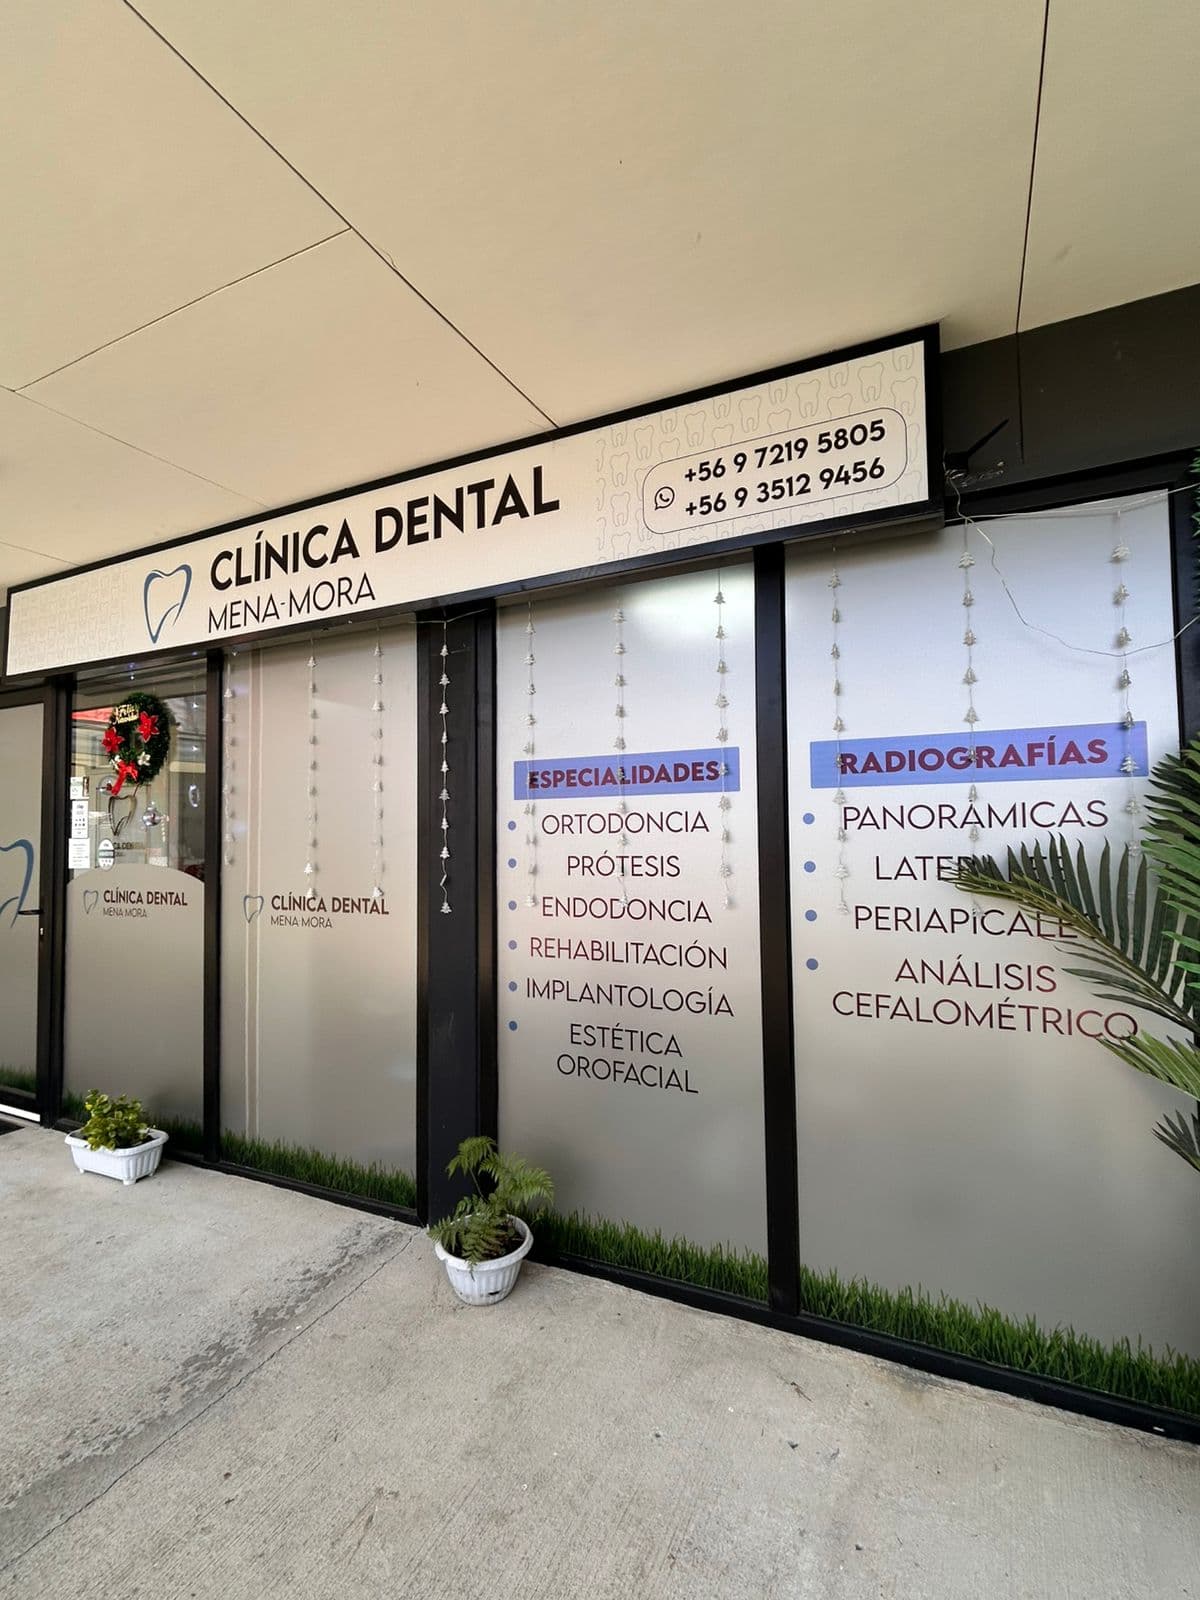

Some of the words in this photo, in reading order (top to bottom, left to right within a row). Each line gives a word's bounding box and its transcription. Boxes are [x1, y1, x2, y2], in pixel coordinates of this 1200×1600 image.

[684, 458, 726, 482] +56
[733, 453, 747, 473] 9
[754, 437, 809, 469] 7219
[817, 419, 886, 454] 5805
[685, 492, 727, 516] +56
[734, 487, 748, 508] 9
[756, 473, 811, 503] 3512
[819, 457, 885, 490] 9456
[210, 517, 360, 591] CLÍNICA
[375, 465, 560, 554] DENTAL
[207, 572, 376, 634] MENA-MORA
[840, 735, 1109, 775] RADIOGRAFÍAS
[528, 760, 720, 790] ESPECIALIDADES
[541, 811, 710, 835] ORTODONCIA
[842, 799, 1109, 831] PANORÁMICAS
[567, 849, 681, 878] PRÓTESIS
[103, 887, 143, 905] CLÍNICA
[146, 891, 188, 906] DENTAL
[271, 891, 327, 912] CLÍNICA
[331, 896, 390, 915] DENTAL
[541, 896, 713, 923] ENDODONCIA
[529, 936, 728, 969] REHABILITACIÓN
[895, 953, 1058, 993] ANÁLISIS
[526, 977, 735, 1017] IMPLANTOLOGÍA
[832, 990, 1138, 1041] CEFALOMÉTRICO
[570, 1022, 683, 1058] ESTÉTICA
[556, 1053, 699, 1094] OROFACIAL
